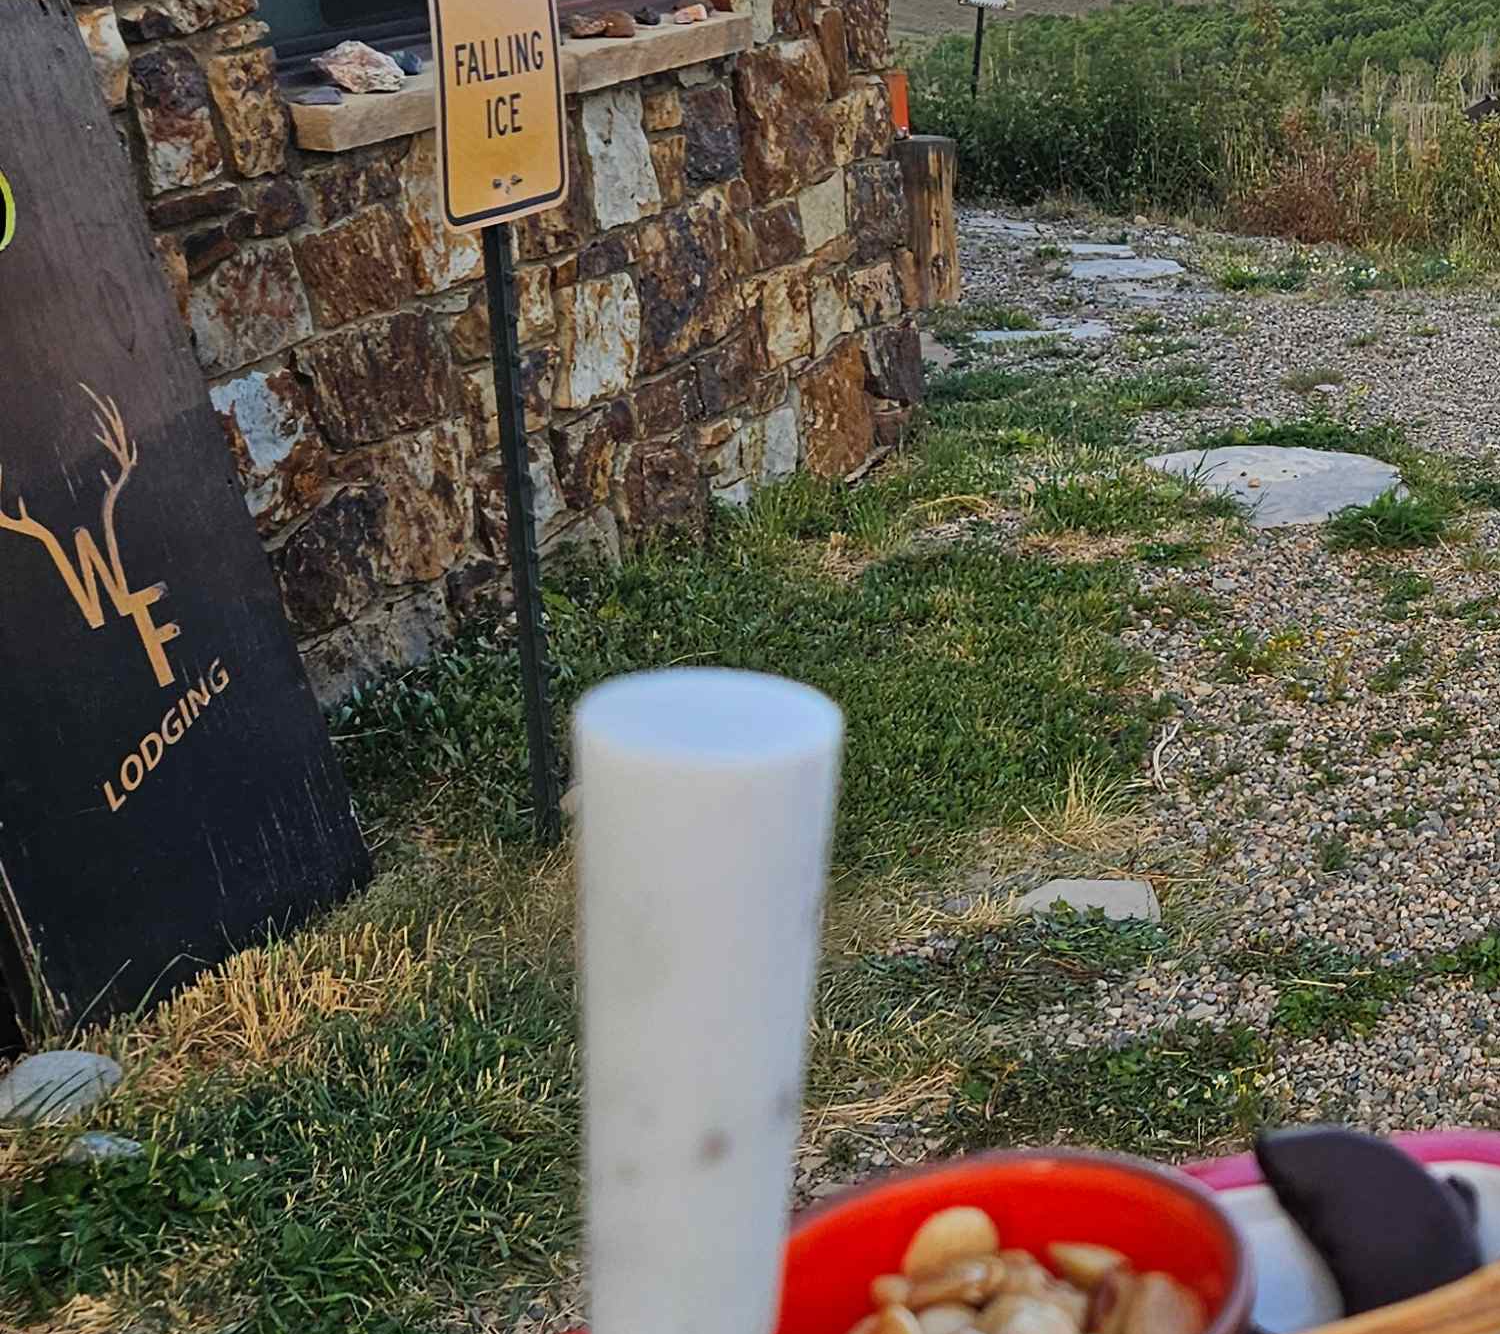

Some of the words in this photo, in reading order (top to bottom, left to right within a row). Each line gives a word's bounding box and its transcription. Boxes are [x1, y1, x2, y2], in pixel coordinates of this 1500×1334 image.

[455, 29, 544, 87] FALLING
[487, 93, 523, 139] ICE
[103, 657, 230, 813] LODGING
